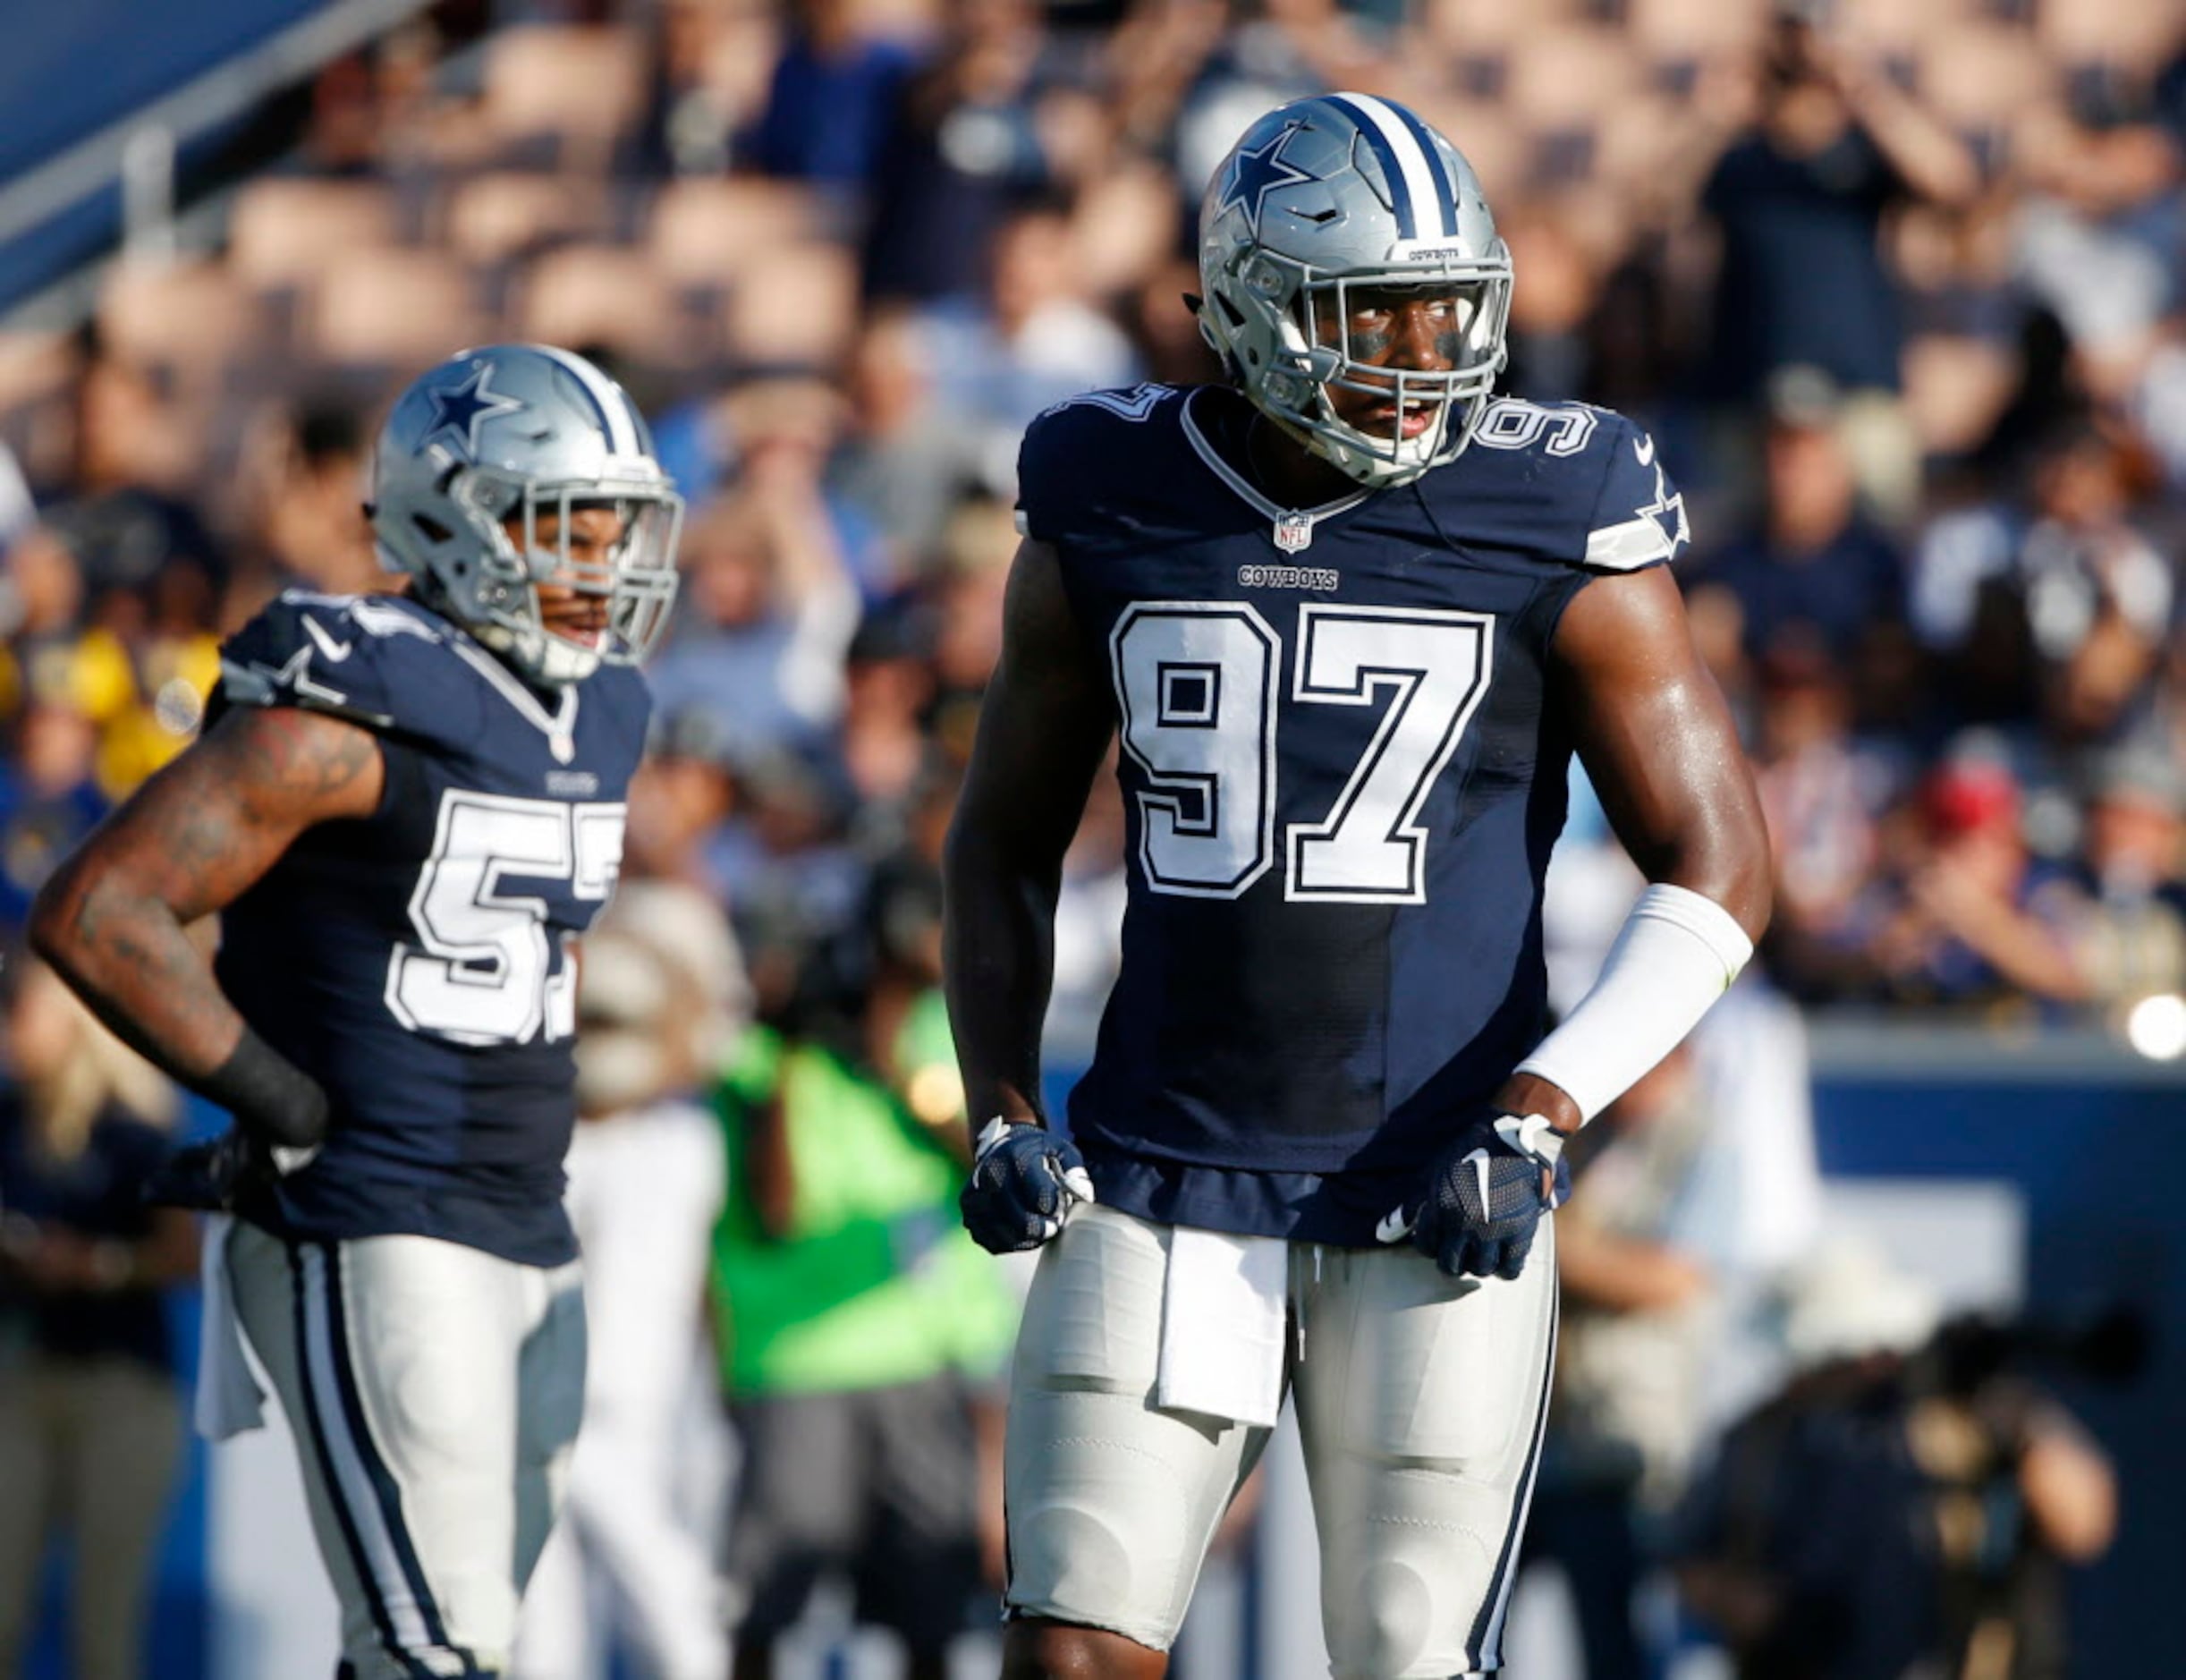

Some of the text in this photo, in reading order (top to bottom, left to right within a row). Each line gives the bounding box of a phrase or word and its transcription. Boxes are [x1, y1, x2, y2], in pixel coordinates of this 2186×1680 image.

[1279, 526, 1308, 545] NFL
[1237, 564, 1340, 591] COWBOYS
[1109, 600, 1495, 904] 97
